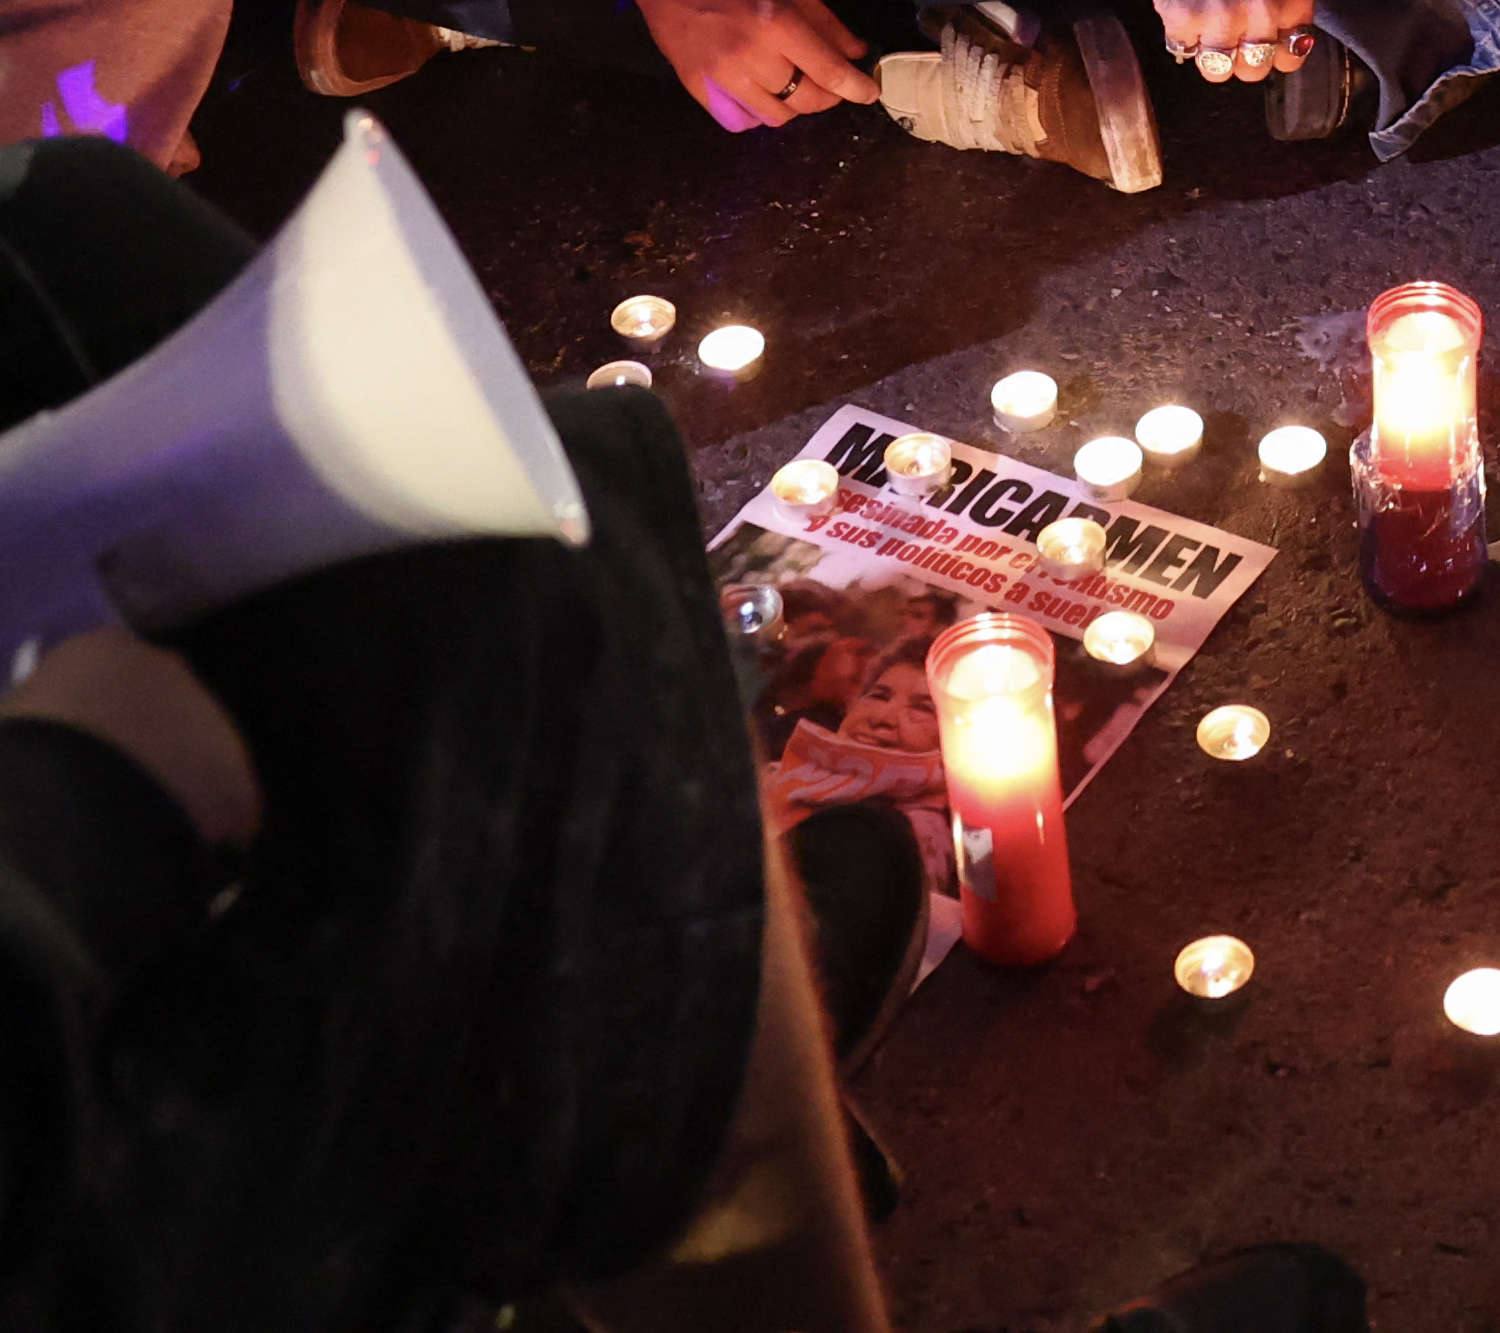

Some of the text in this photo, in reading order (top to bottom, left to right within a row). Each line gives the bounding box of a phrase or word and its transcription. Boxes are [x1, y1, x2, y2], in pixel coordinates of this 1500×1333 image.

[824, 422, 1244, 599] MRICAMEN
[837, 488, 959, 545] sesinada
[952, 533, 1013, 561] por
[825, 521, 884, 548] sus
[875, 536, 1008, 593] políticos
[1004, 581, 1031, 605] a
[1027, 590, 1102, 630] suel
